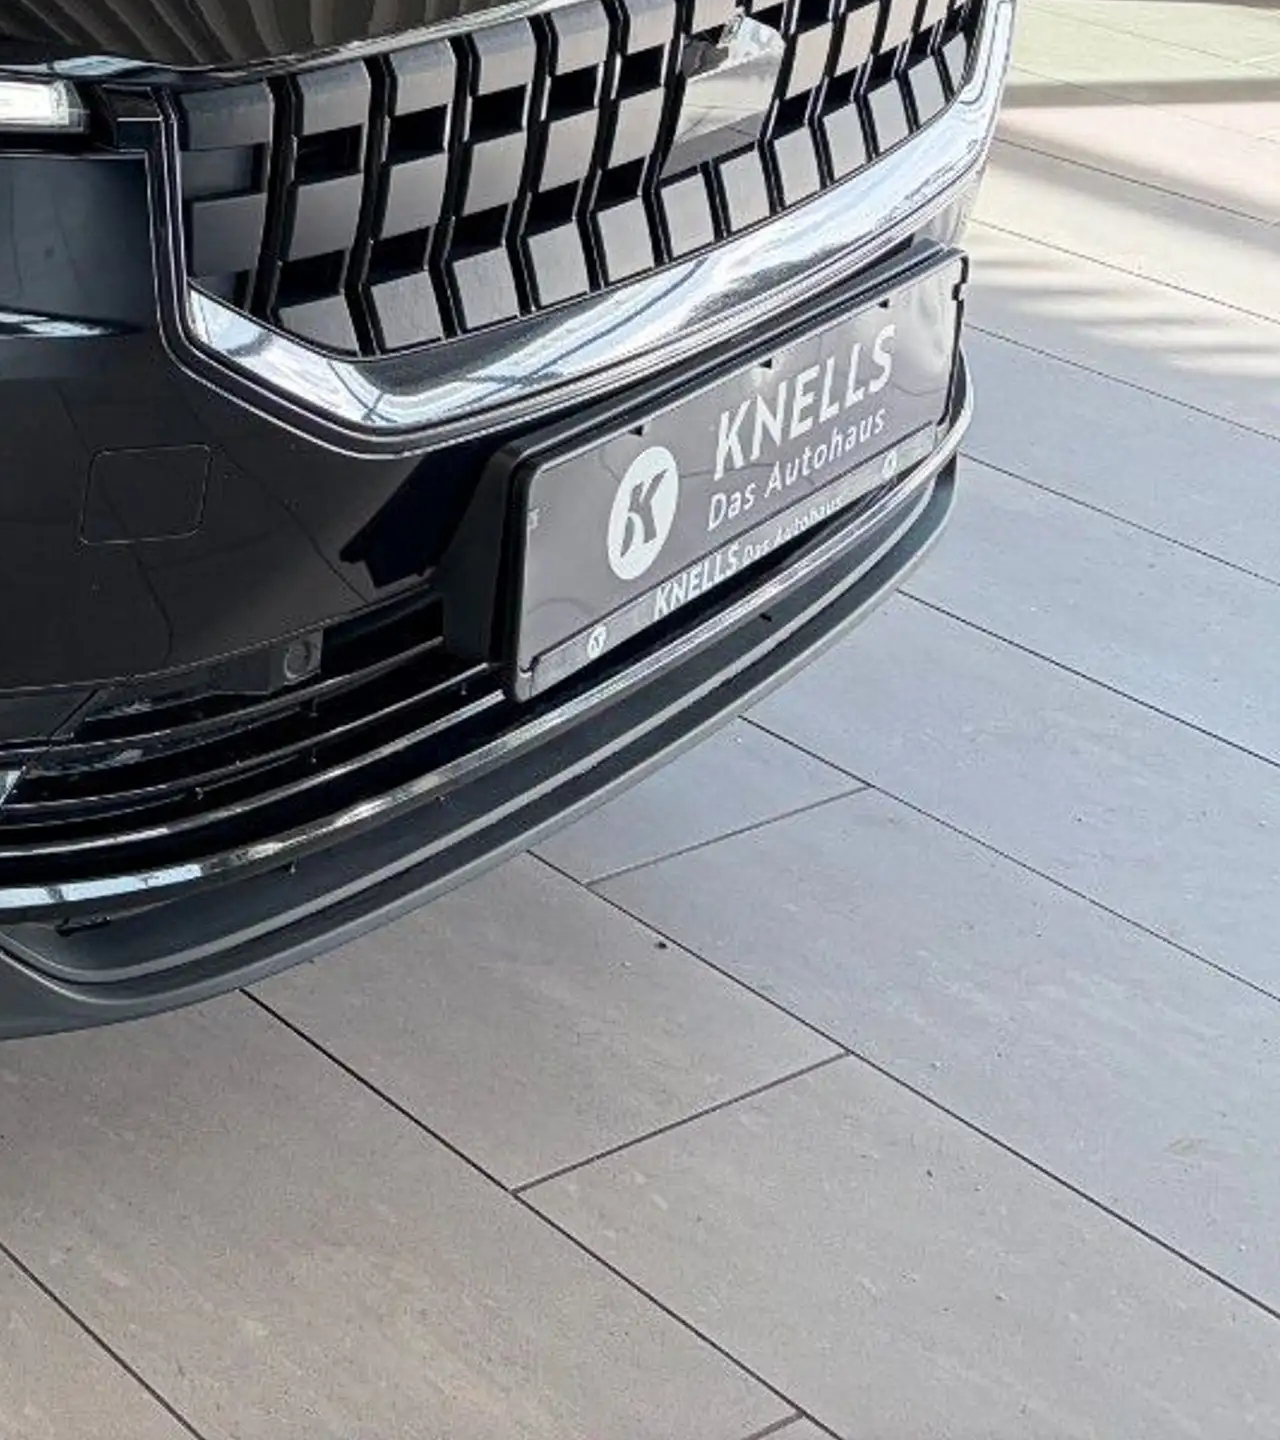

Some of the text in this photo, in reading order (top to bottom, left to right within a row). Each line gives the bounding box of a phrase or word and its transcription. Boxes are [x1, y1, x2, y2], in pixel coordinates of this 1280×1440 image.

[713, 323, 897, 482] KNELLS
[706, 482, 757, 532] Das
[763, 407, 887, 499] Autohaus
[653, 542, 742, 621] KNELLS
